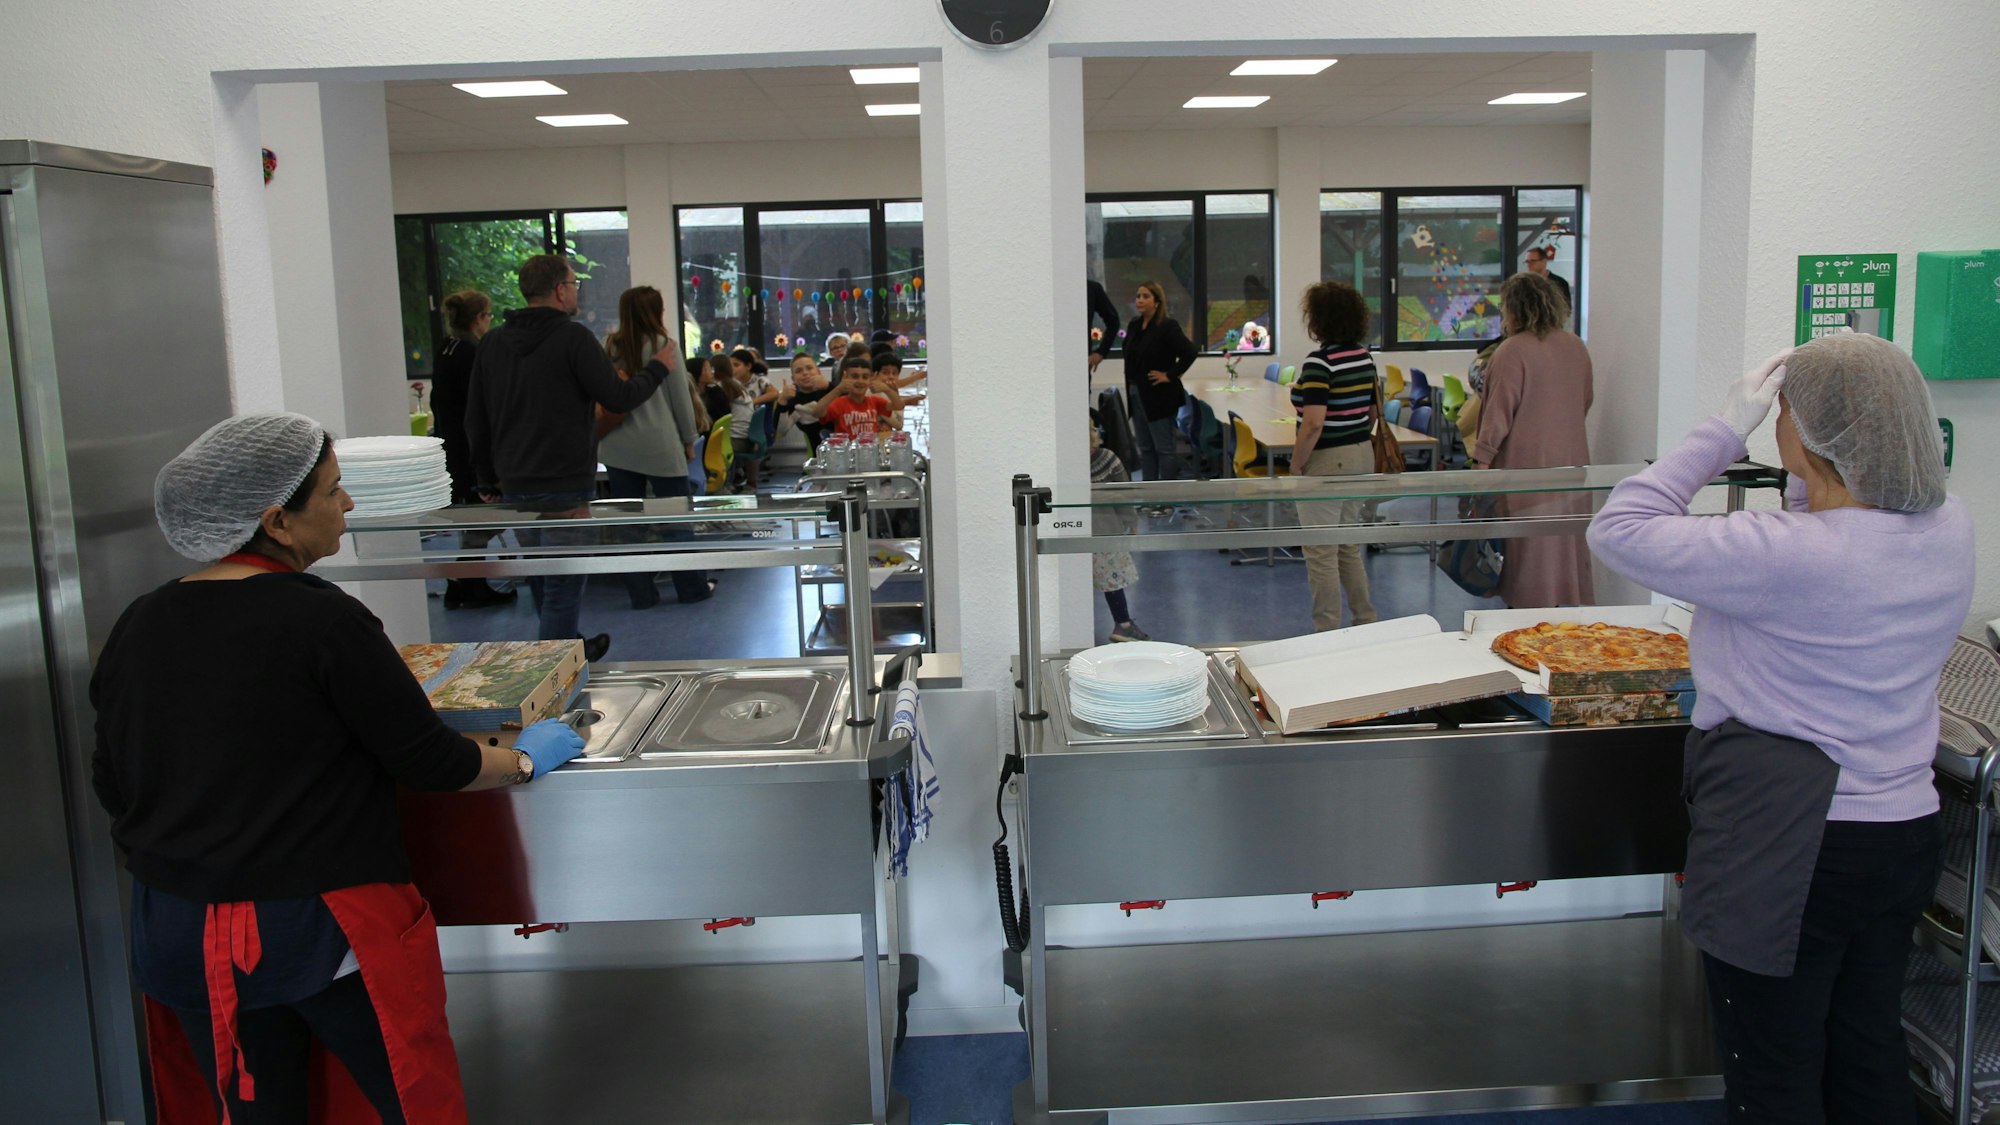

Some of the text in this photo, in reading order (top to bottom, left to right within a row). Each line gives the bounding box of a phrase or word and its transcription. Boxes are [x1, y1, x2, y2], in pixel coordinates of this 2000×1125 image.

[989, 20, 1004, 43] 6
[1862, 260, 1891, 273] plum
[1964, 260, 1985, 270] plum
